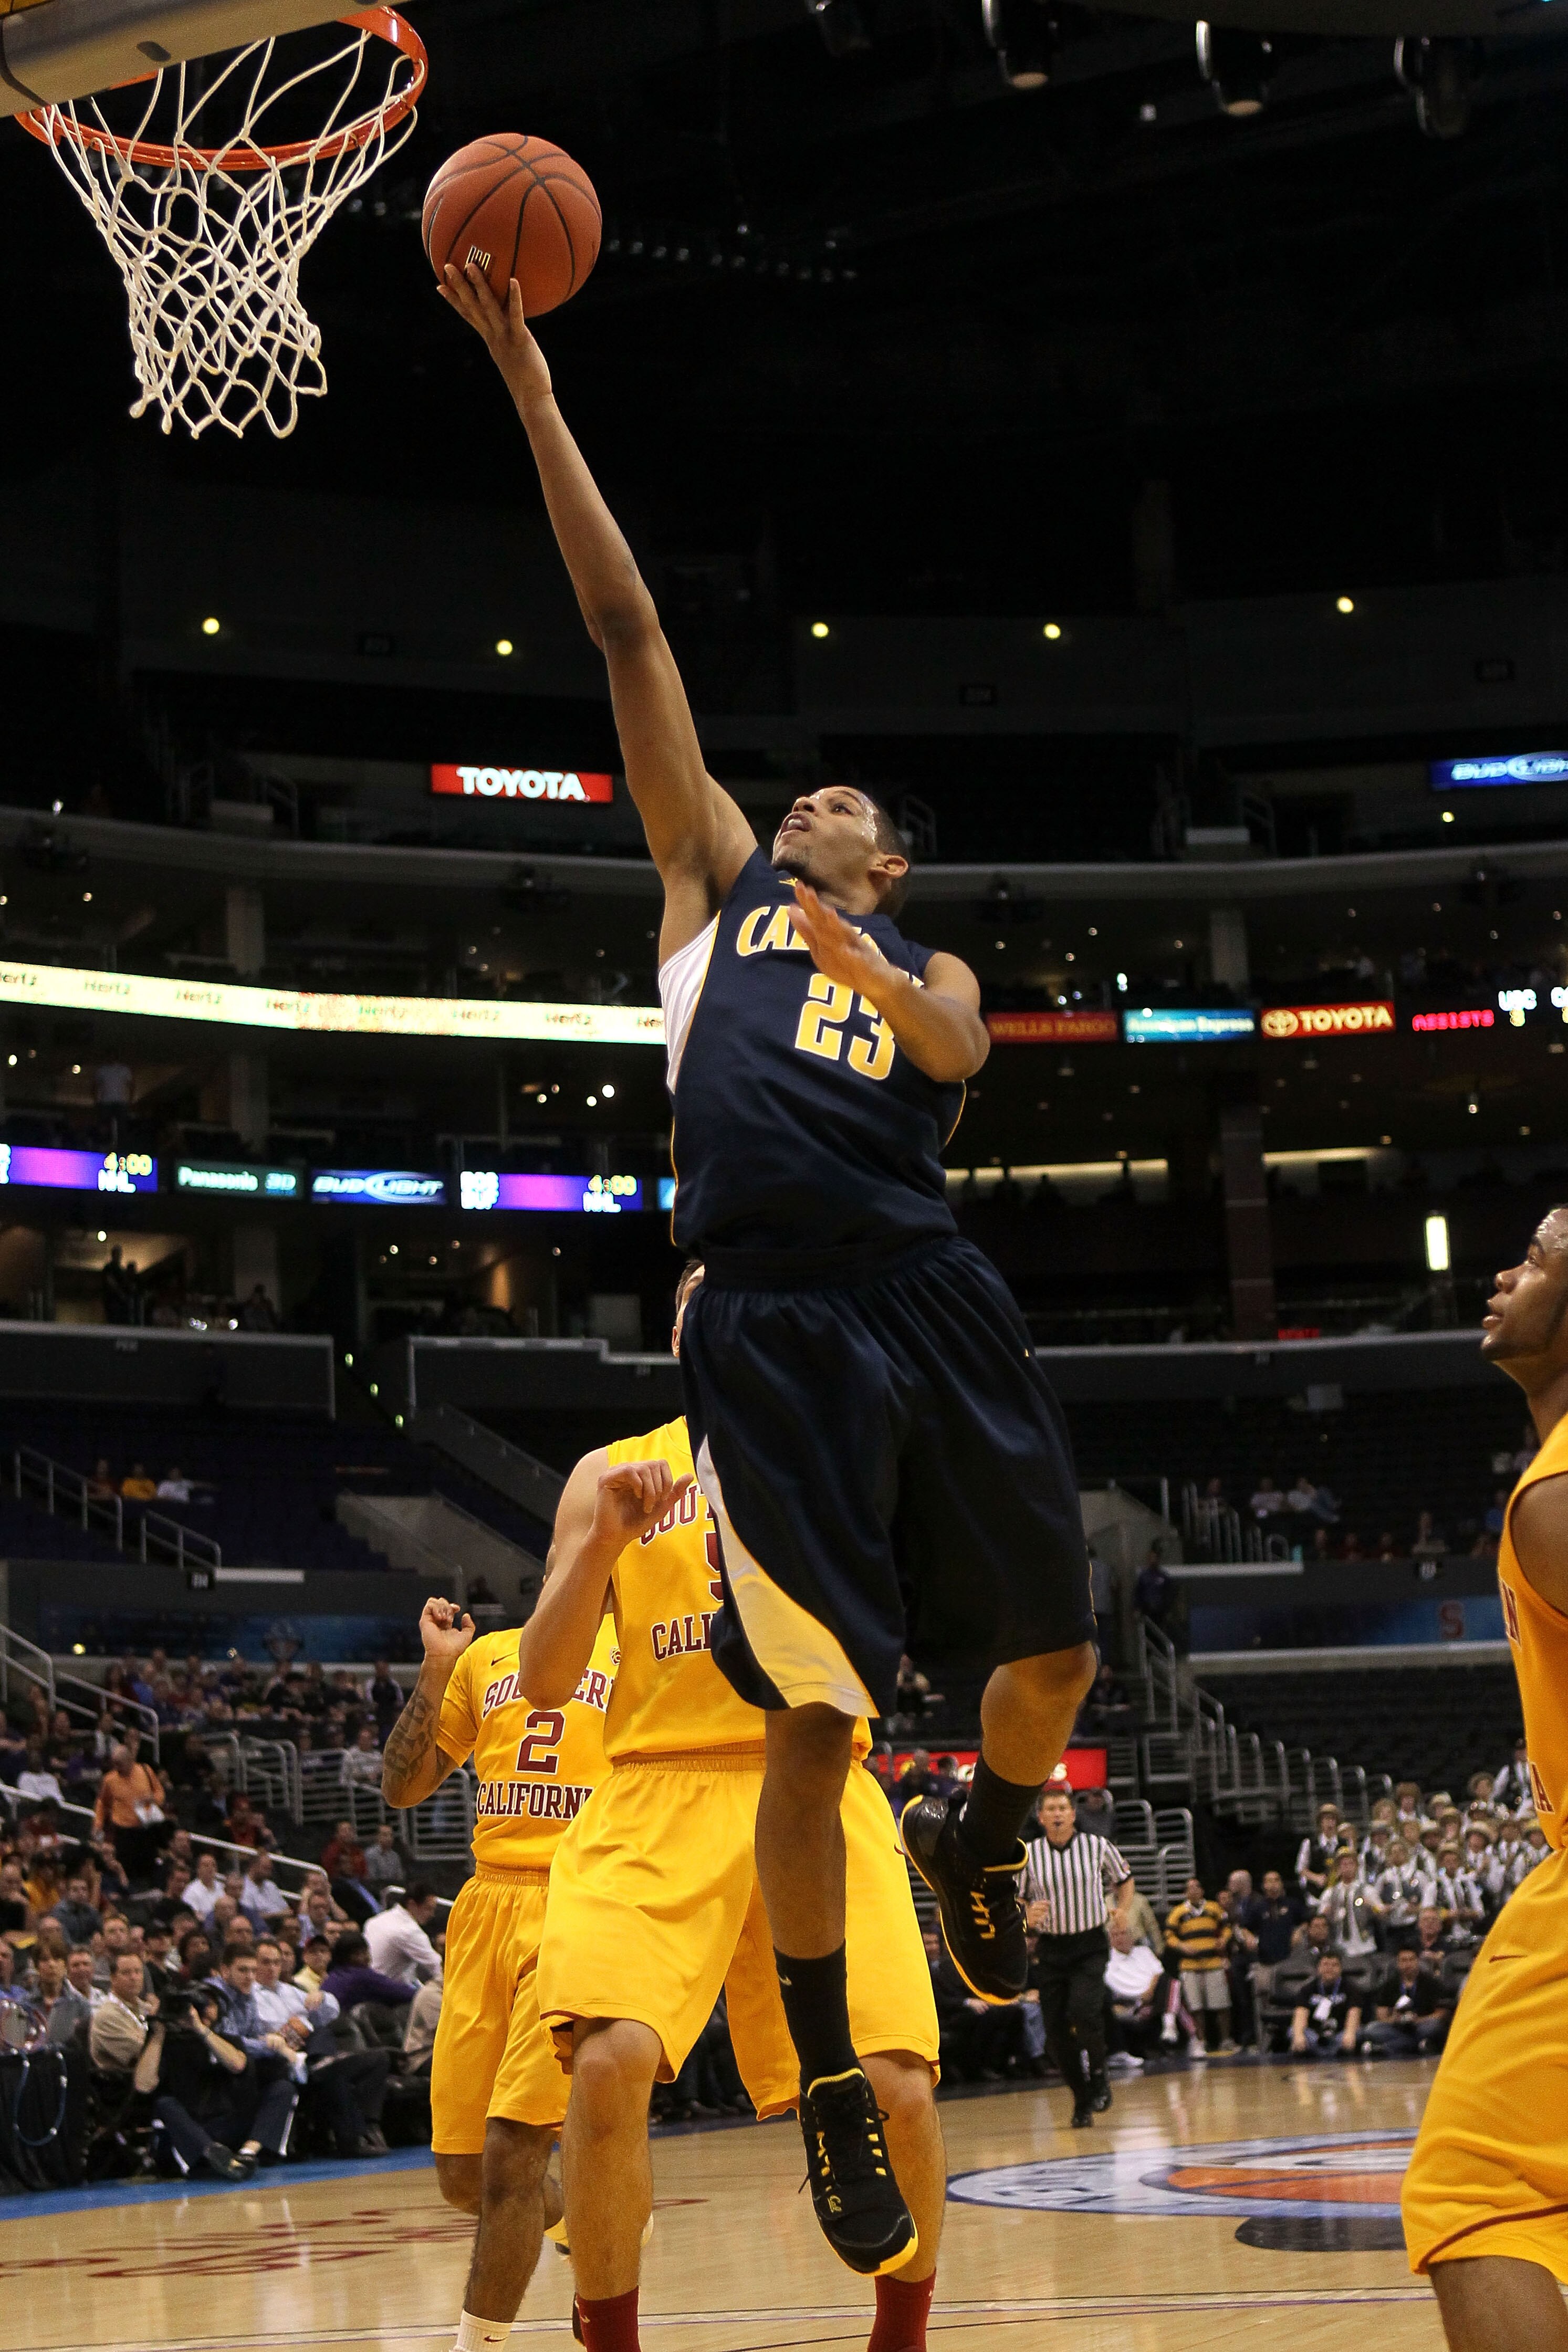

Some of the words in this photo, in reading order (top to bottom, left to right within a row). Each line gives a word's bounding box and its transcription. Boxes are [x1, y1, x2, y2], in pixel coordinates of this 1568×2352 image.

[456, 766, 586, 801] TOYOTA
[795, 973, 895, 1080] 23
[1299, 1005, 1393, 1033] TOYOTA
[178, 1166, 259, 1191] Panasonic
[313, 1176, 366, 1194] BUD
[372, 1178, 444, 1196] LIGHT
[515, 1709, 567, 1775] 2
